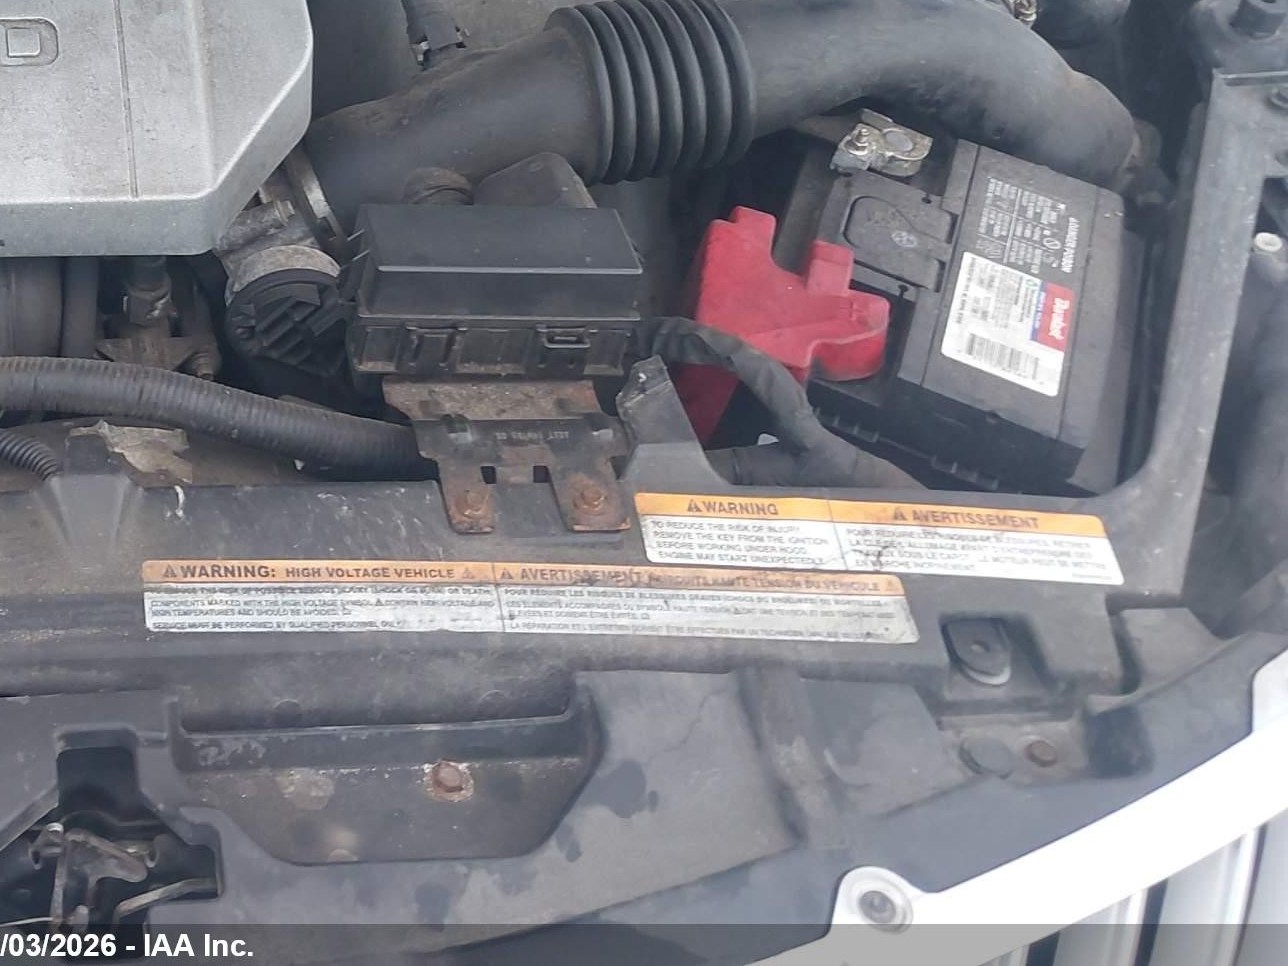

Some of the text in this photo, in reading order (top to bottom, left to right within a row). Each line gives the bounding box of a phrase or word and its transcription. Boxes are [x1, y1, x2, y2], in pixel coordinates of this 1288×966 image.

[701, 501, 779, 515] WARNING
[913, 509, 1039, 528] AVERTISSEMENT
[181, 565, 455, 579] WARNING: HIGH VOLTAGE VEHICLE
